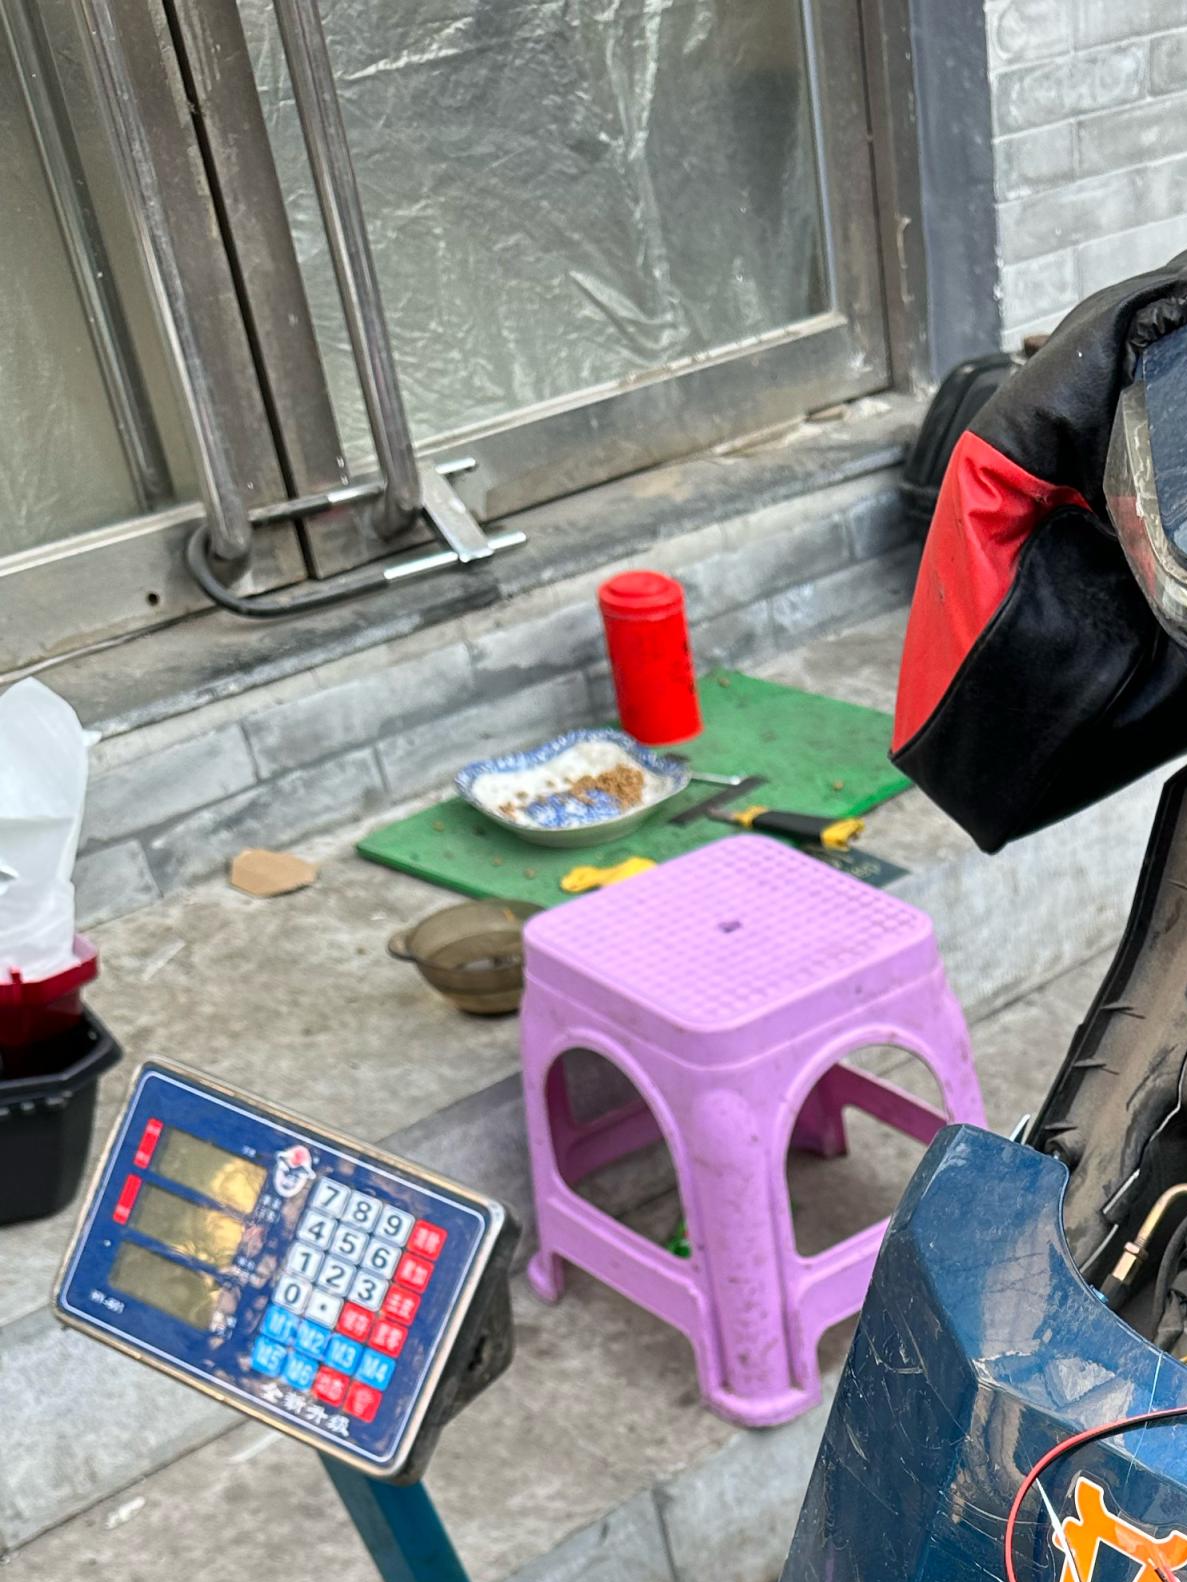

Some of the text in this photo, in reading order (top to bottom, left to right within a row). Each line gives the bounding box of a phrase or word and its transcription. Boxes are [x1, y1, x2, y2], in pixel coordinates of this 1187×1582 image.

[323, 1186, 403, 1237] 7 8 9
[308, 1221, 390, 1269] 4 5 6
[283, 1283, 301, 1304] 0
[300, 1252, 377, 1301] 1 2 3
[257, 1341, 312, 1386] M5 M6
[269, 1311, 294, 1336] M1
[300, 1323, 325, 1352] M2
[331, 1337, 356, 1367] M3
[362, 1352, 389, 1383] M4
